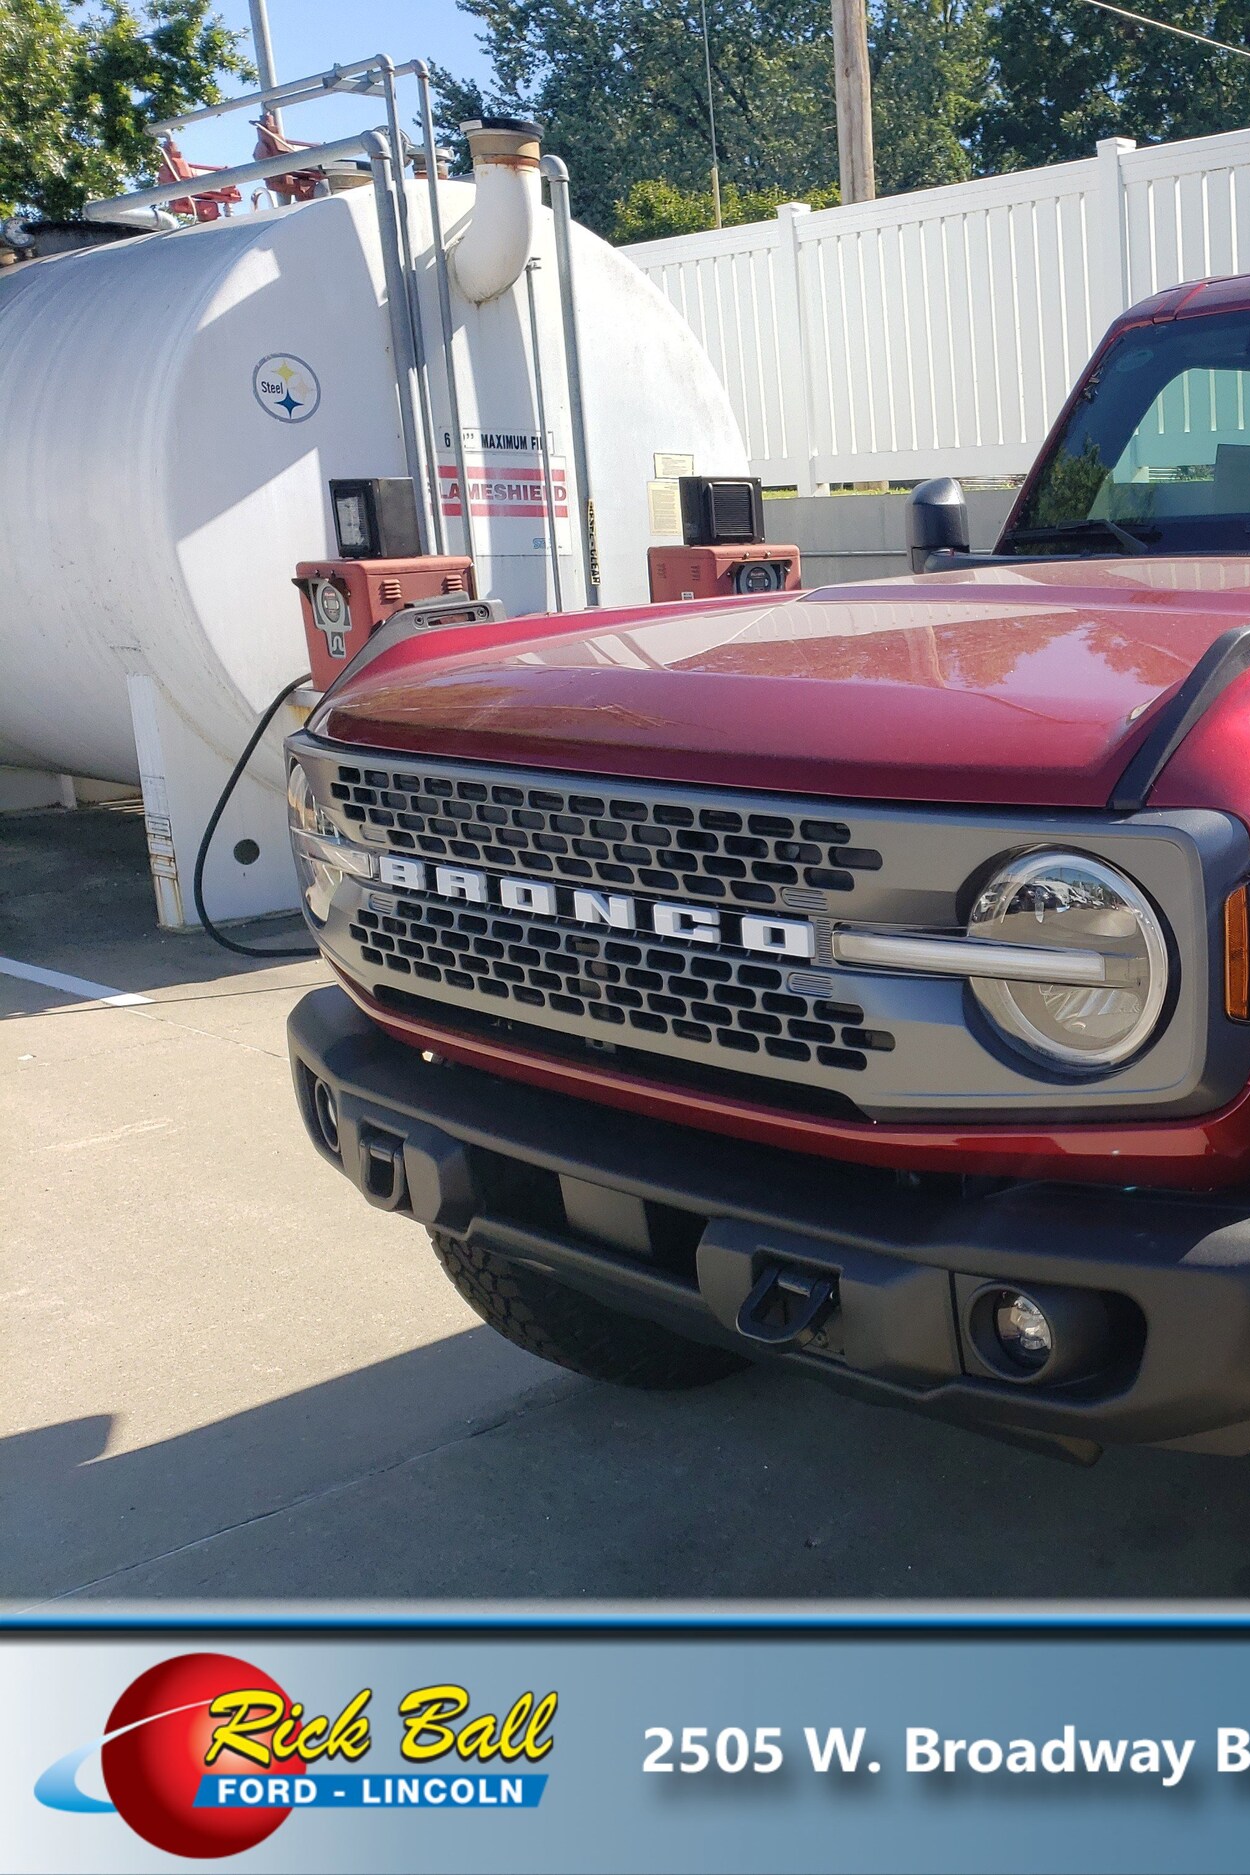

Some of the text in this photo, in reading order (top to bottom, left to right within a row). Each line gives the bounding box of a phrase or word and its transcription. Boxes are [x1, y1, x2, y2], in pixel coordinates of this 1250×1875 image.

[261, 380, 284, 395] Steel
[481, 433, 528, 450] MAXIMUM
[379, 853, 816, 960] BRONCO
